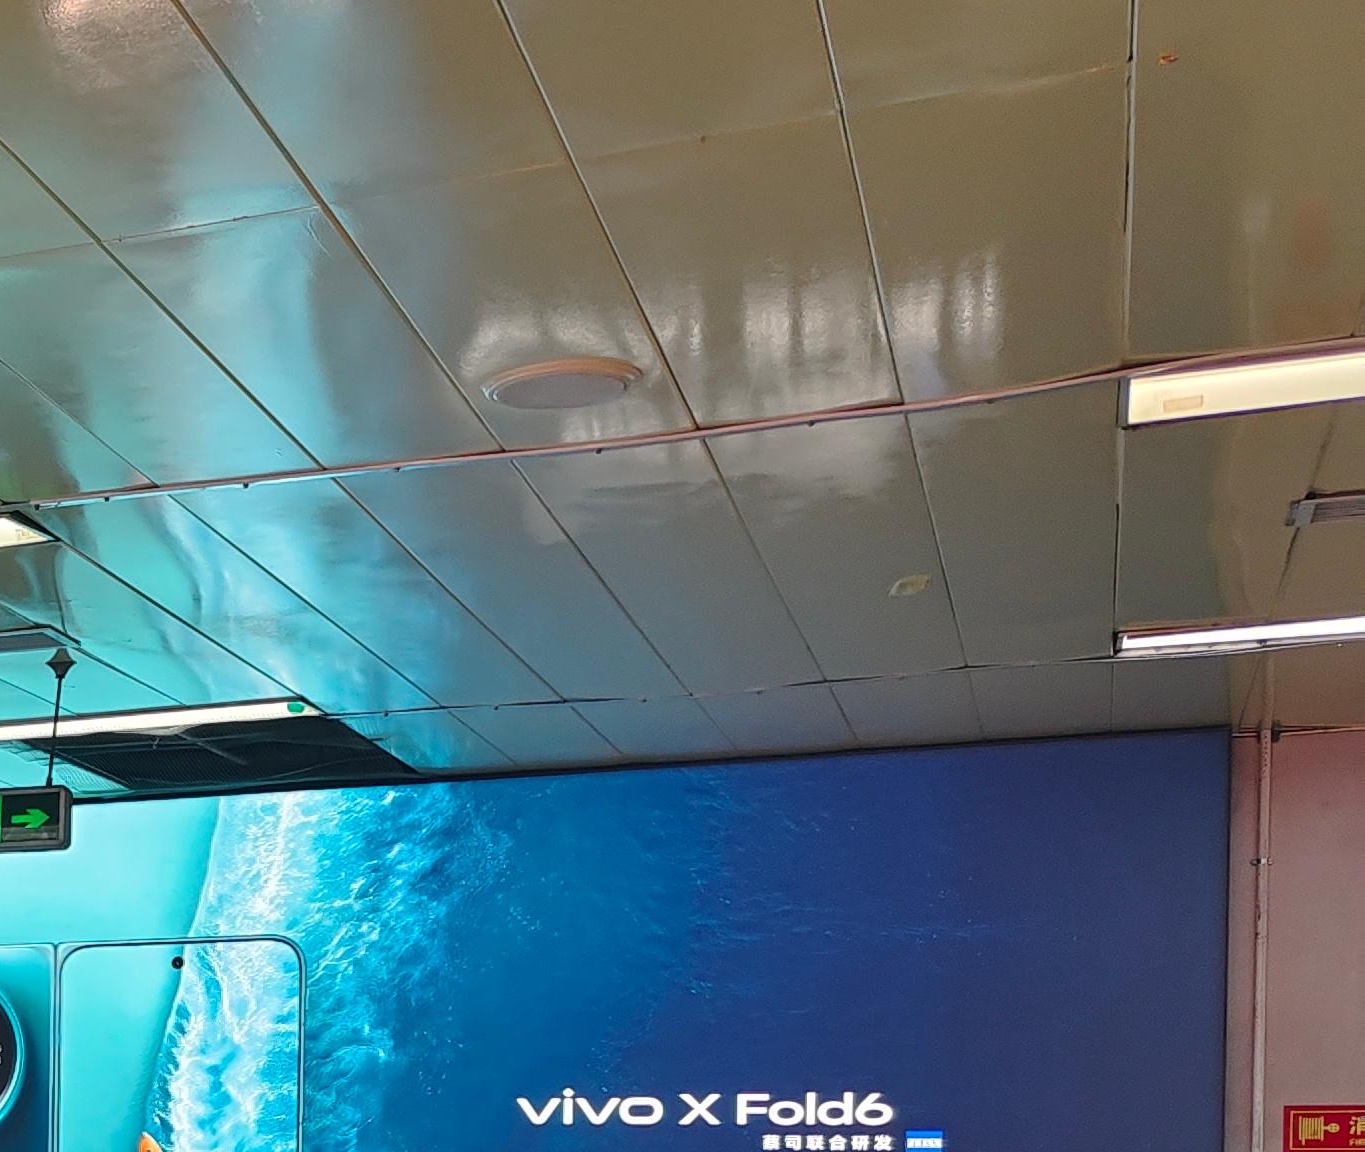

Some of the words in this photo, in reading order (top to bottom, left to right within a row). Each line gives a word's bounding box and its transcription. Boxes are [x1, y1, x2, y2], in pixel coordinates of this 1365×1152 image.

[516, 1087, 664, 1125] vivo
[678, 1093, 721, 1126] X
[736, 1091, 894, 1126] Fold6
[762, 1134, 893, 1152] 蔡司联合研发
